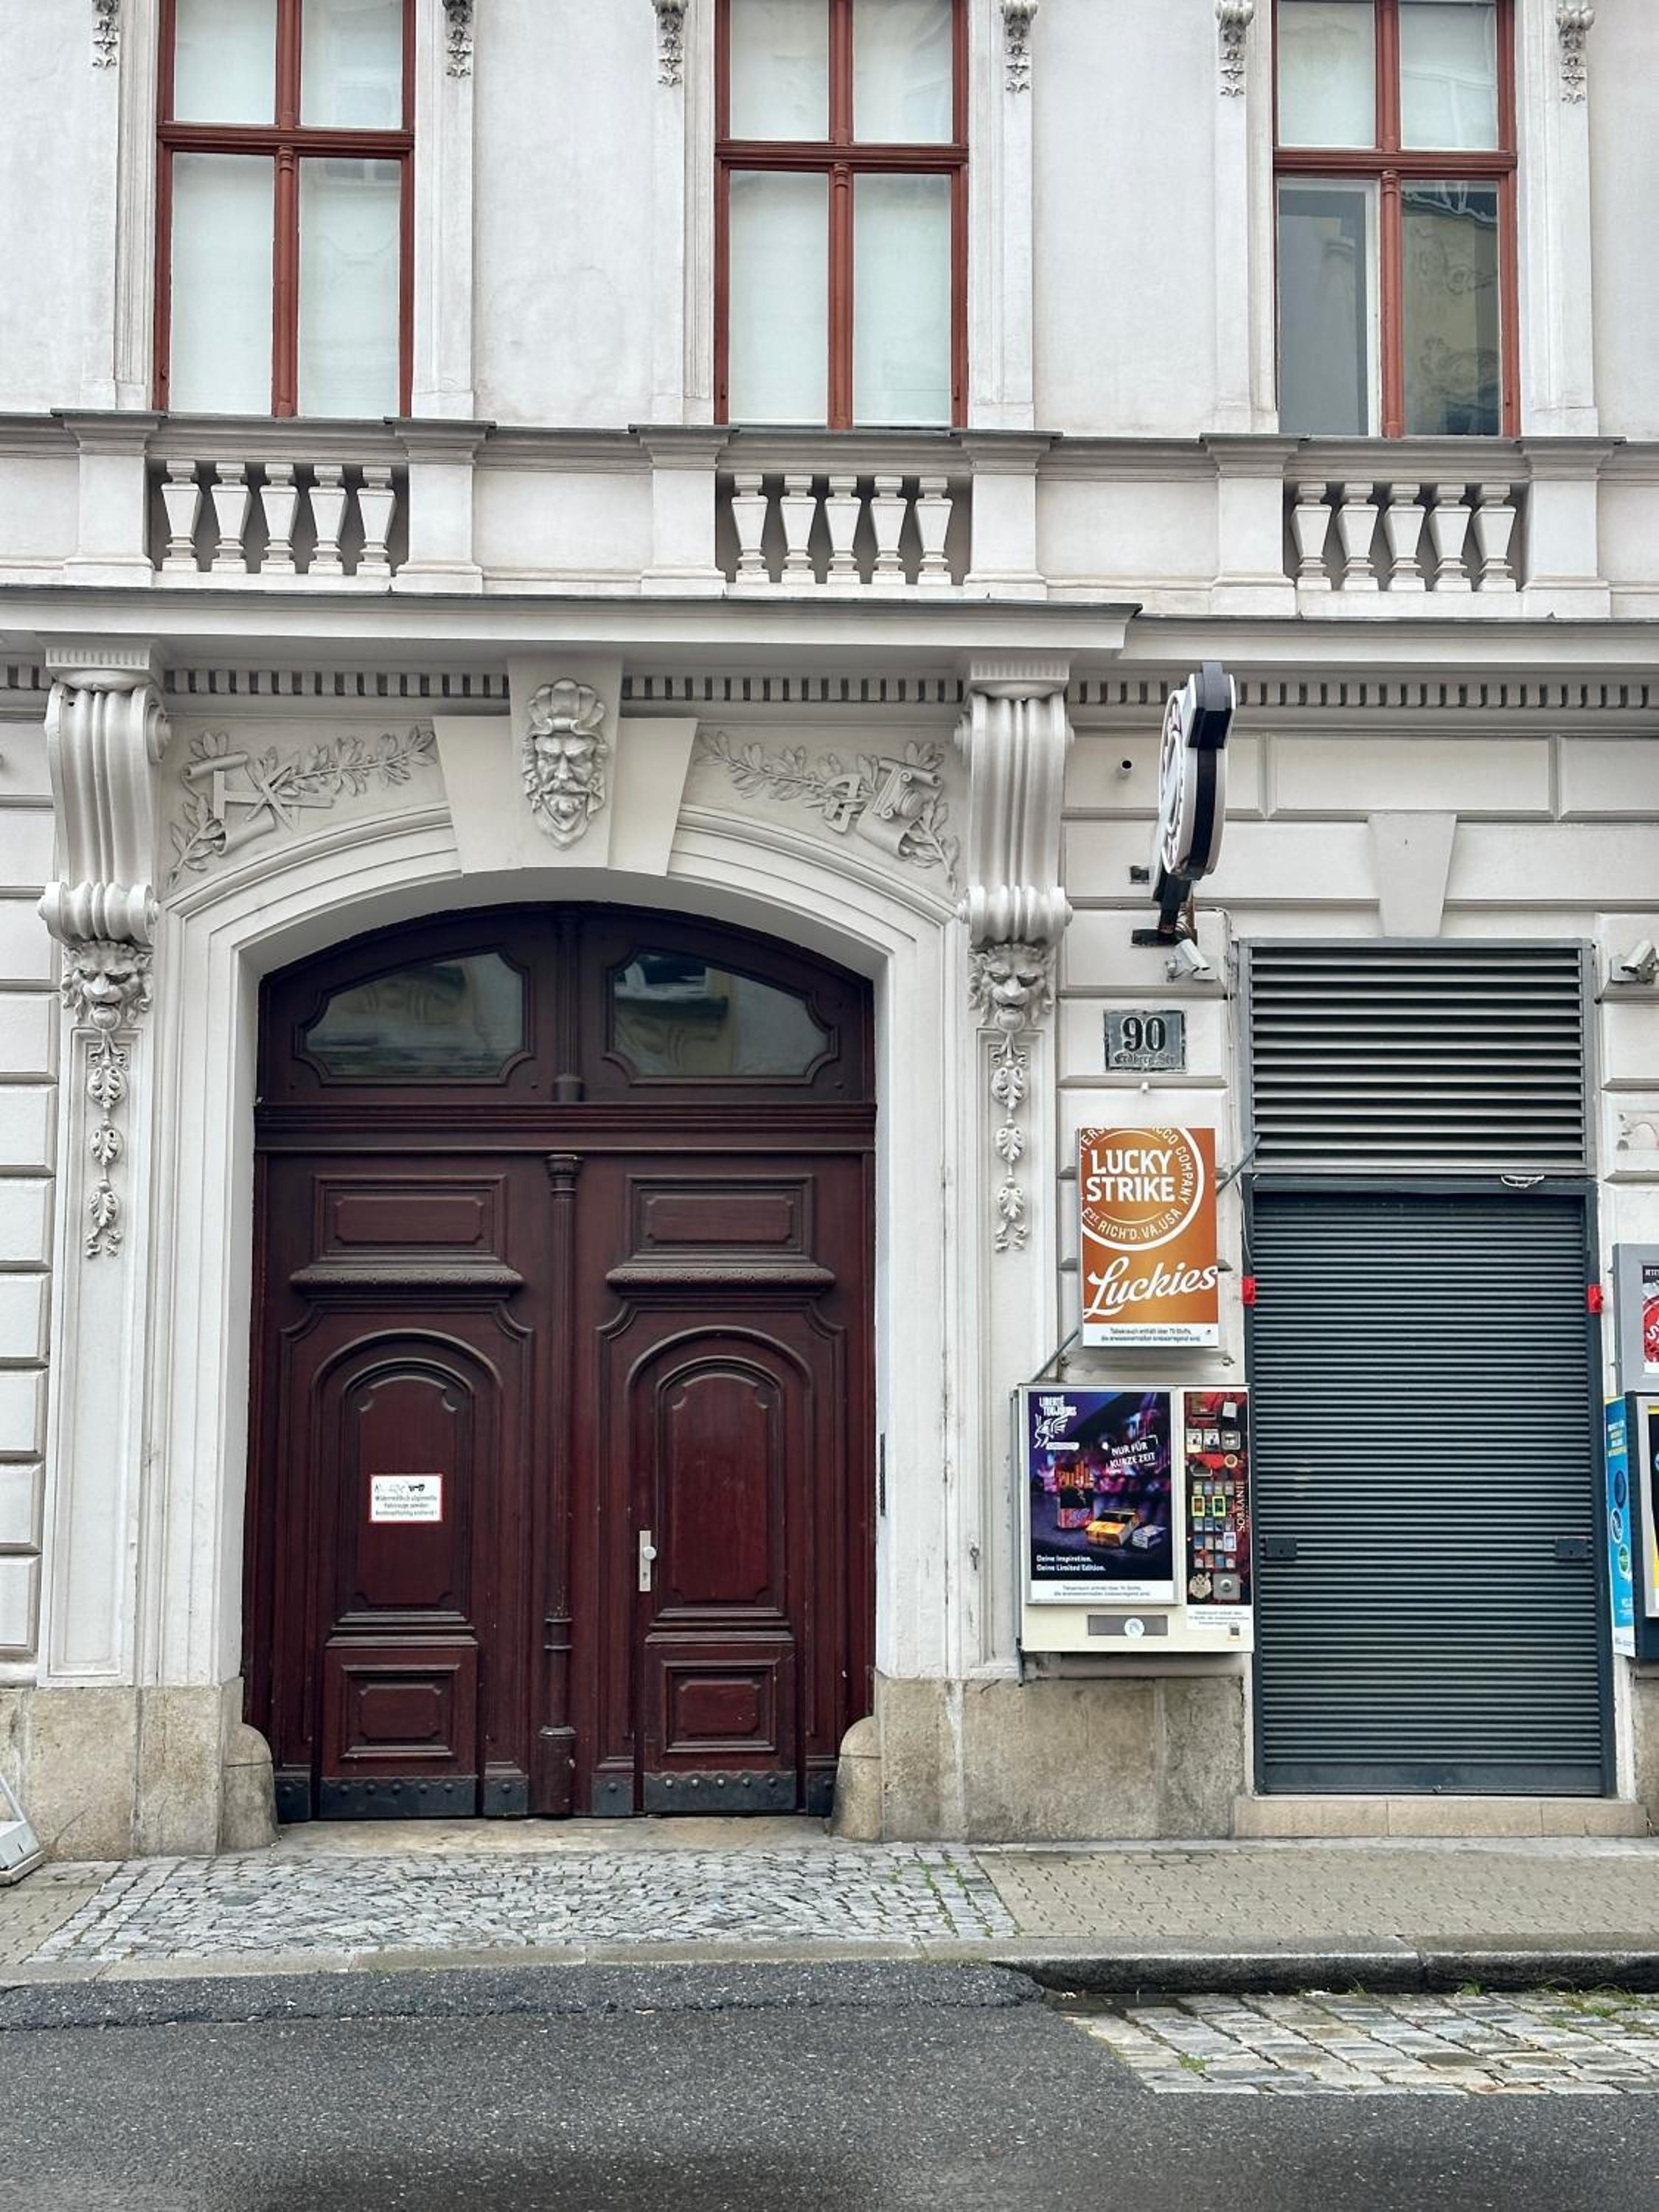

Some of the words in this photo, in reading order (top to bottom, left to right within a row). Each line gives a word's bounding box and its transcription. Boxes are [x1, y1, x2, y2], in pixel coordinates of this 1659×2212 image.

[1121, 1017, 1166, 1051] 90
[1091, 1149, 1172, 1175] LUCKY
[1175, 1146, 1194, 1205] COMPANY
[1086, 1176, 1175, 1203] STRIKE
[1159, 1208, 1182, 1229] USA
[1082, 1256, 1218, 1319] Luckies
[1110, 1455, 1137, 1468] KURZE
[1138, 1452, 1155, 1463] ZEIT
[1111, 1444, 1130, 1456] NUR
[1131, 1440, 1148, 1453] FÜR
[1056, 1555, 1093, 1564] Inspiration.
